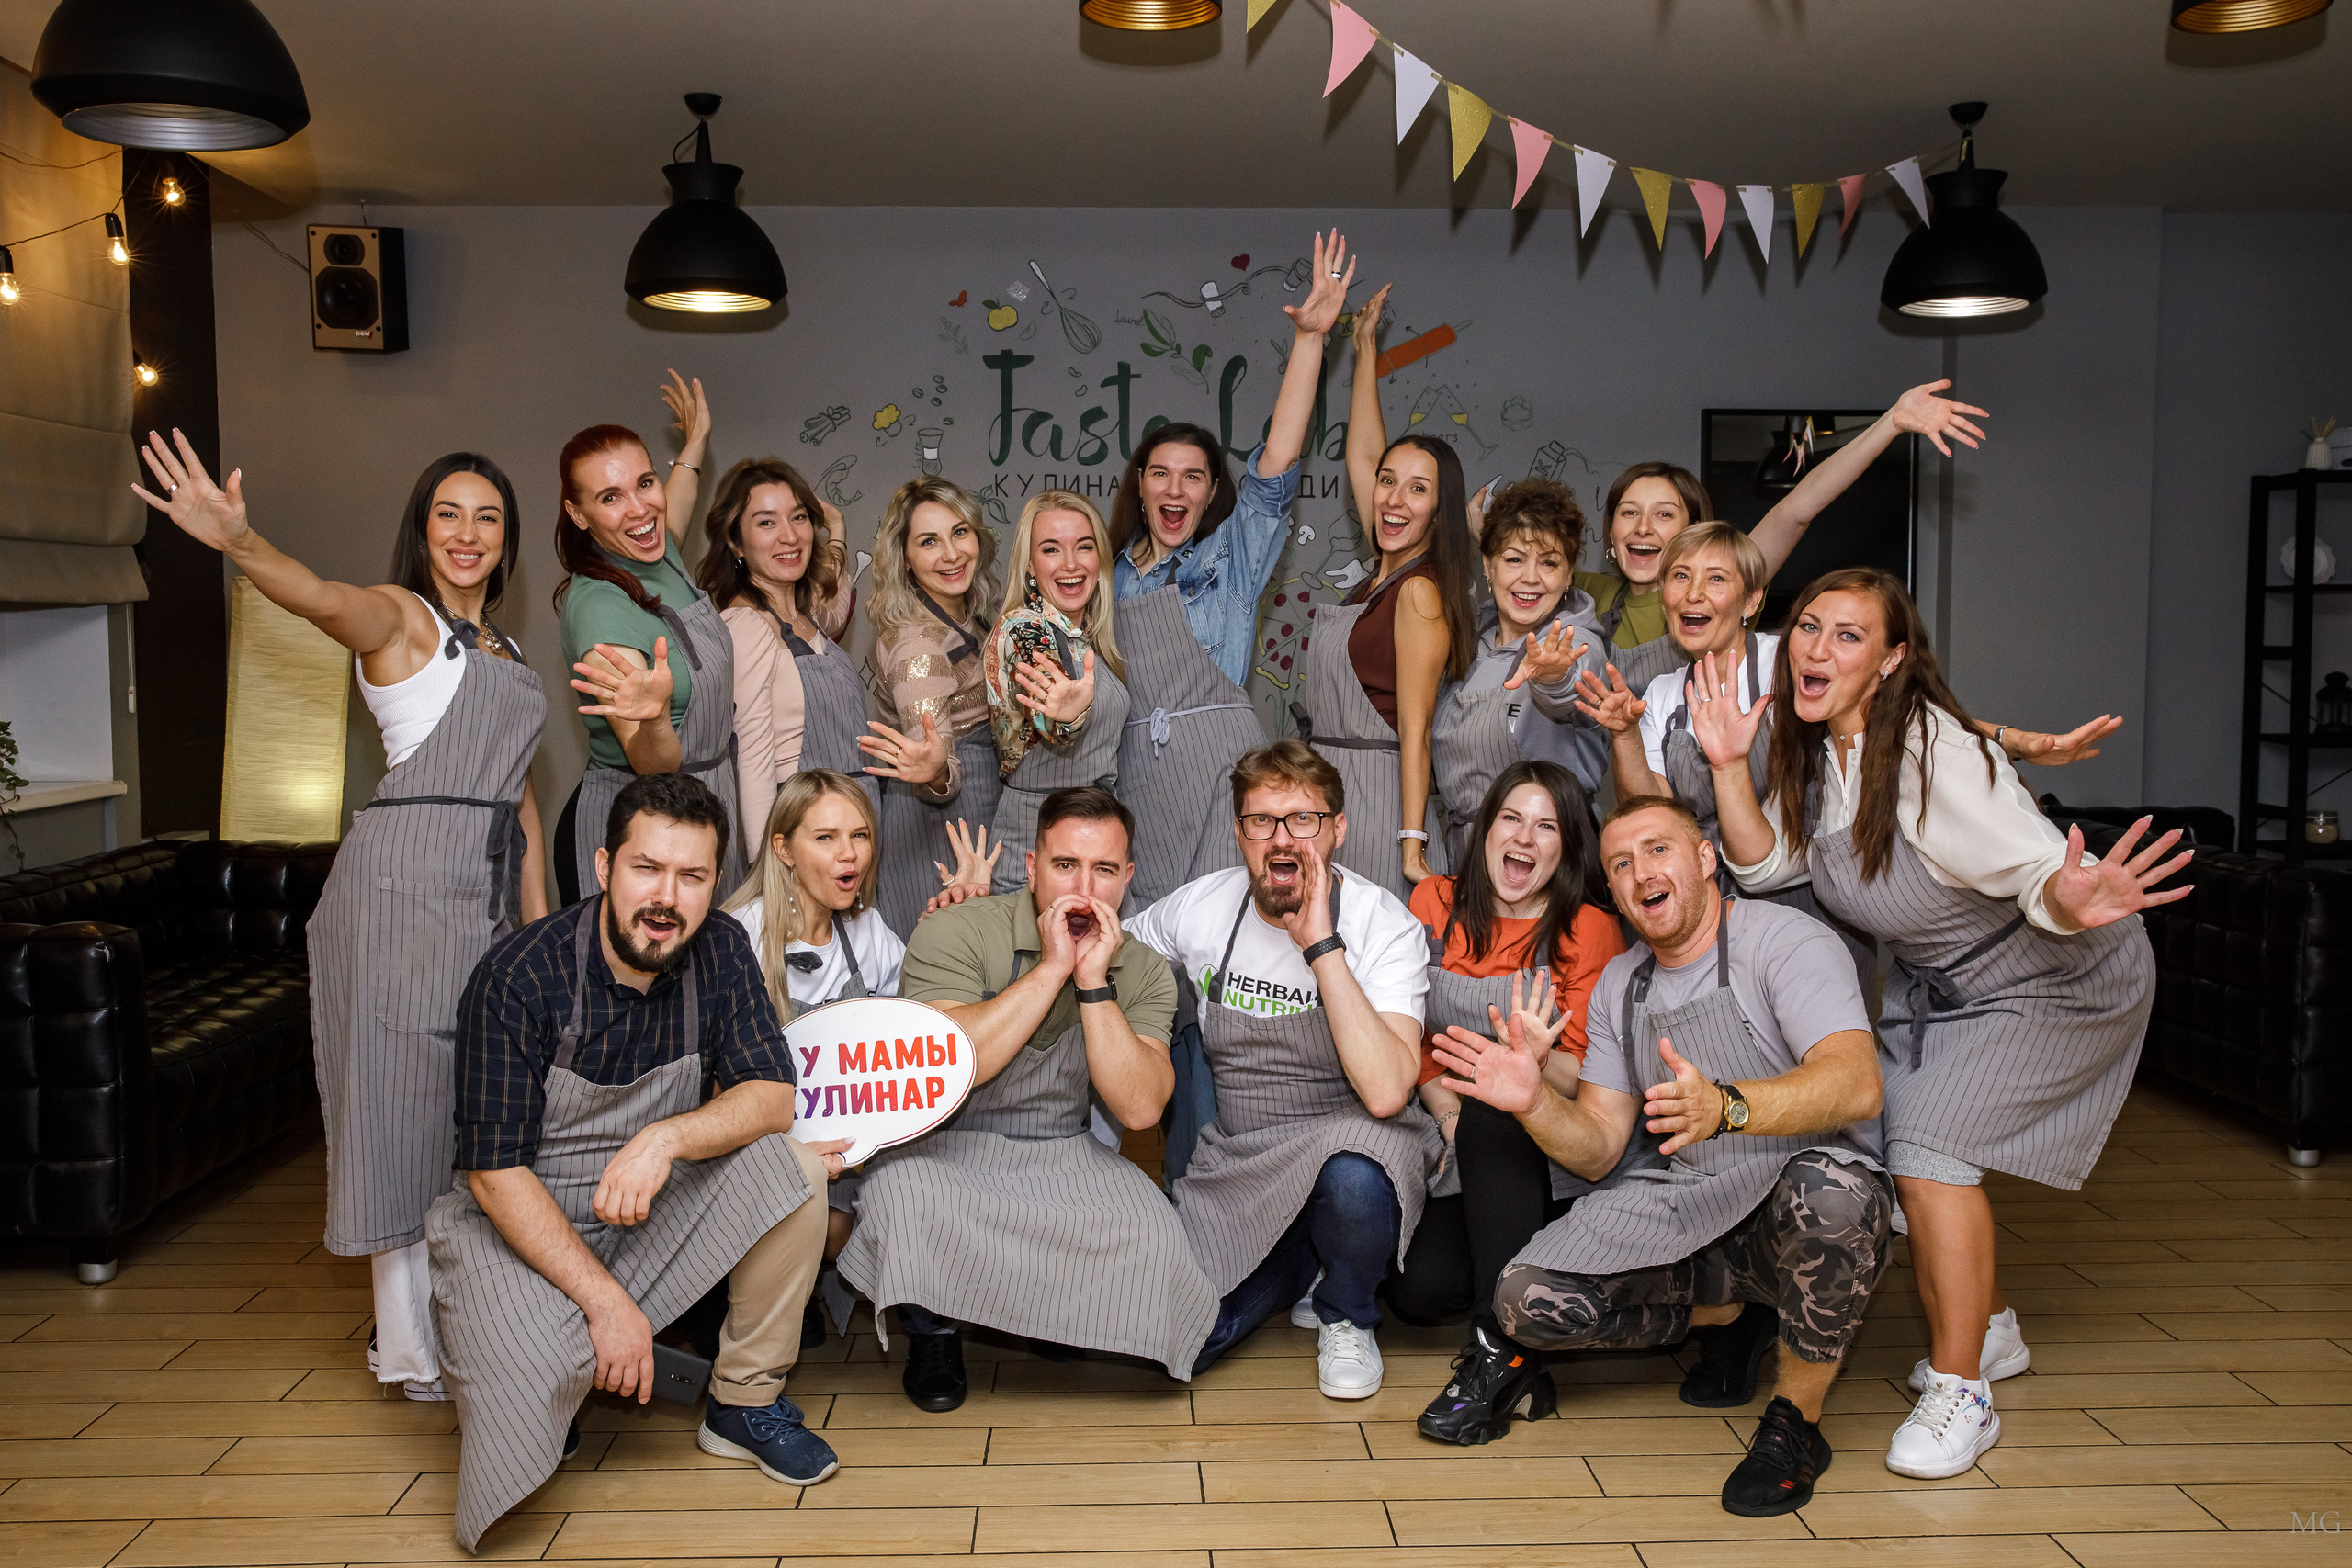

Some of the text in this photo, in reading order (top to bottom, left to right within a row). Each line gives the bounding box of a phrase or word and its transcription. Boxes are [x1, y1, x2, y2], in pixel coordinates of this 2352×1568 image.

[1219, 355, 1349, 462] Lb
[995, 474, 1119, 497] КУЛИНА
[1223, 988, 1313, 1016] NUTRI
[1227, 972, 1317, 1005] HERBAL
[799, 1033, 957, 1077] У МАМЫ
[794, 1076, 945, 1120] УЛИНАР
